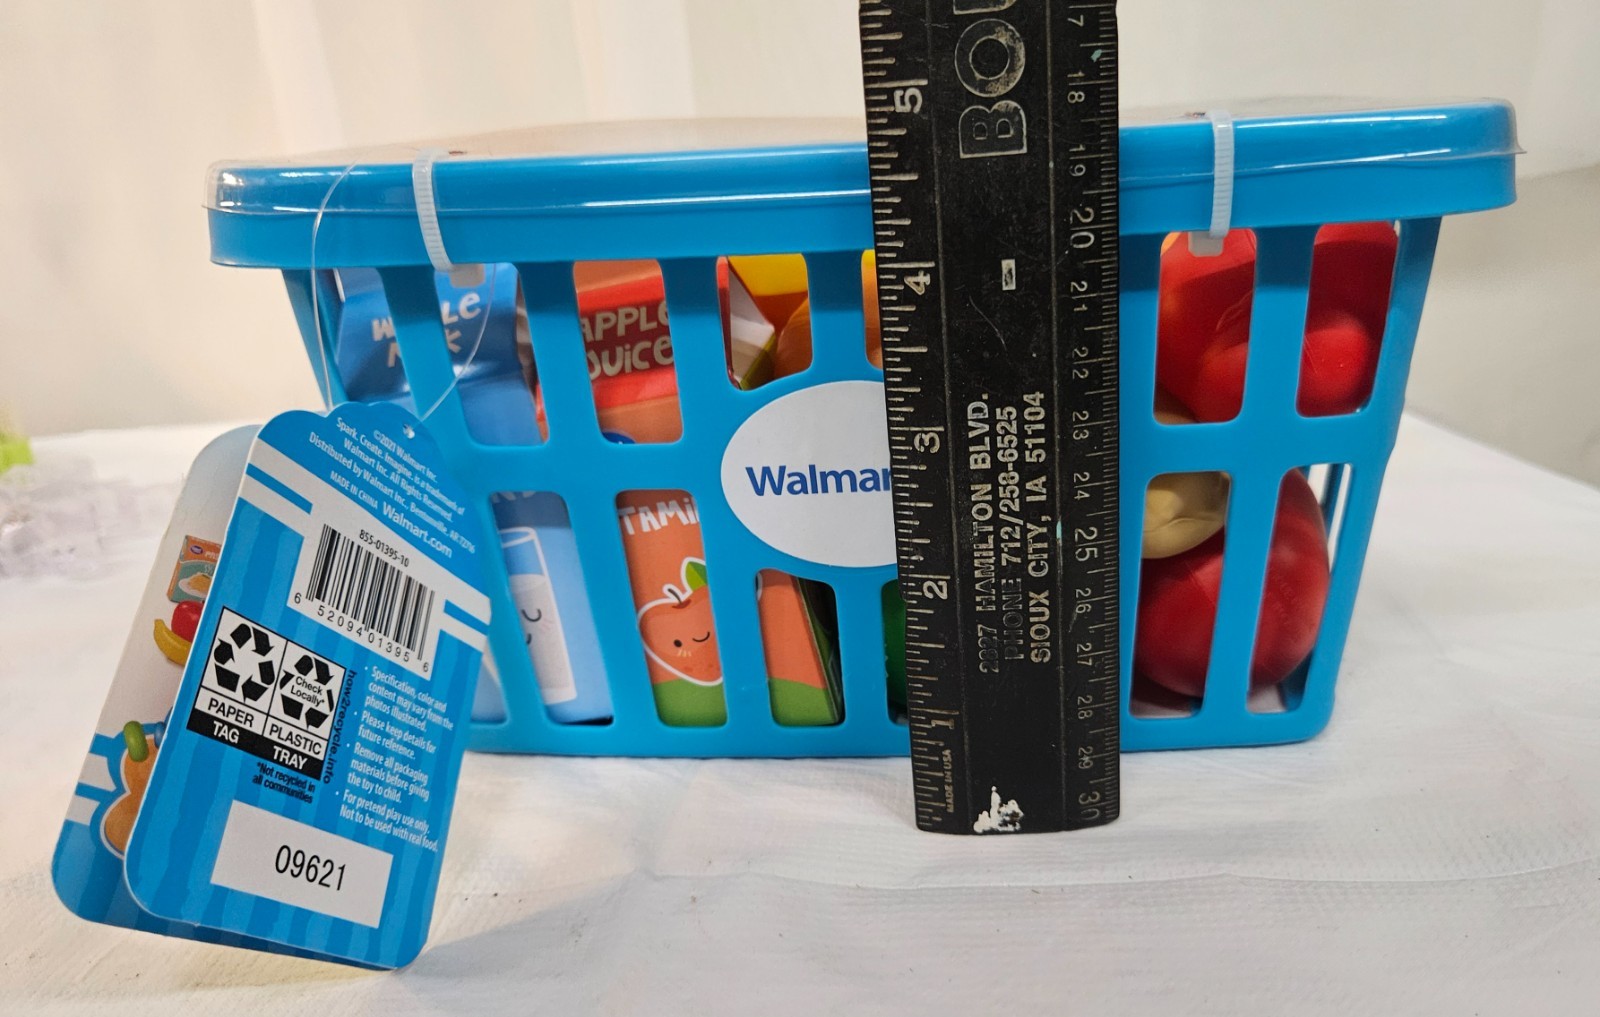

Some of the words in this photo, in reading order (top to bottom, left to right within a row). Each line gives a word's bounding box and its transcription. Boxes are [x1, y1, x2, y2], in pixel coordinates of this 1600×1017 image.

[953, 0, 1027, 158] BO
[1067, 71, 1086, 104] 18
[893, 87, 923, 114] 5
[1069, 143, 1086, 177] 19
[1069, 206, 1095, 249] 20
[904, 270, 931, 295] 4
[1070, 280, 1088, 312] 21
[1072, 346, 1089, 380] 22
[966, 393, 991, 470] BLVD.
[1023, 391, 1046, 463] 51104
[1072, 410, 1089, 440] 23
[396, 445, 426, 474] Walmart
[913, 432, 941, 453] 3
[309, 431, 353, 470] Distributed
[352, 462, 363, 478] by
[363, 469, 394, 498] Walmart
[336, 417, 358, 441] Spark.
[360, 434, 383, 459] Create.
[384, 452, 414, 481] Imagine.
[425, 482, 457, 511] trademark
[344, 437, 376, 468] Walmart
[376, 461, 389, 478] Inc.
[389, 472, 401, 486] All
[400, 478, 422, 501] Rights
[746, 463, 891, 497] Walmar
[330, 470, 350, 491] MADE
[350, 484, 359, 496] IN
[358, 490, 379, 510] CHINA
[996, 406, 1024, 566] 712/258-6525
[1025, 475, 1047, 502] IA
[1073, 471, 1091, 501] 24
[382, 501, 453, 559] Walmart.com
[970, 483, 996, 611] HAMILTON
[1026, 515, 1052, 577] CITY,
[1075, 526, 1098, 562] 25
[359, 529, 410, 568] 855-01395-10
[923, 579, 948, 600] 2
[1075, 587, 1092, 614] 26
[294, 592, 302, 604] 6
[423, 662, 429, 673] 6
[1001, 577, 1025, 660] PHONE
[1028, 590, 1051, 663] SIOUX
[1076, 642, 1093, 667] 27
[295, 676, 323, 696] Check
[371, 665, 417, 699] Specification,
[417, 691, 435, 708] color
[434, 700, 448, 713] and
[207, 697, 255, 728] PAPER
[364, 695, 391, 714] photos
[390, 706, 427, 733] illustrated.
[368, 682, 397, 703] content
[396, 696, 412, 712] may
[411, 702, 428, 719] vary
[427, 708, 444, 726] from
[443, 717, 454, 731] the
[1077, 695, 1093, 720] 28
[213, 720, 240, 744] TAG
[269, 723, 322, 755] PLASTIC
[323, 670, 358, 784] how2recycle.info
[361, 710, 386, 731] Please
[385, 721, 403, 741] keep
[403, 730, 426, 750] details
[425, 740, 437, 754] for
[931, 719, 954, 730] 1
[273, 745, 308, 770] TRAY
[358, 724, 382, 745] future
[382, 736, 416, 760] reference.
[942, 749, 952, 769] USA
[1078, 746, 1094, 769] 29
[350, 759, 386, 782] materials
[386, 772, 409, 791] before
[408, 782, 430, 802] giving
[353, 741, 384, 765] Remove
[384, 756, 395, 770] all
[393, 760, 429, 786] packaging
[944, 771, 953, 783] IN
[252, 774, 264, 785] all
[263, 779, 314, 804] communities
[274, 771, 307, 791] recycled
[308, 781, 316, 792] in
[347, 771, 361, 787] the
[361, 778, 375, 794] toy
[374, 783, 383, 796] to
[383, 786, 402, 804] child.
[944, 784, 954, 813] MADE
[339, 804, 355, 820] Not
[355, 810, 364, 823] to
[363, 813, 375, 828] be
[374, 817, 393, 835] used
[392, 825, 409, 841] with
[408, 830, 423, 846] real
[422, 835, 439, 853] food.
[342, 789, 356, 805] For
[355, 796, 387, 818] pretend
[385, 806, 402, 825] play
[401, 813, 415, 828] use
[414, 818, 430, 835] only.
[274, 844, 347, 891] 09621
